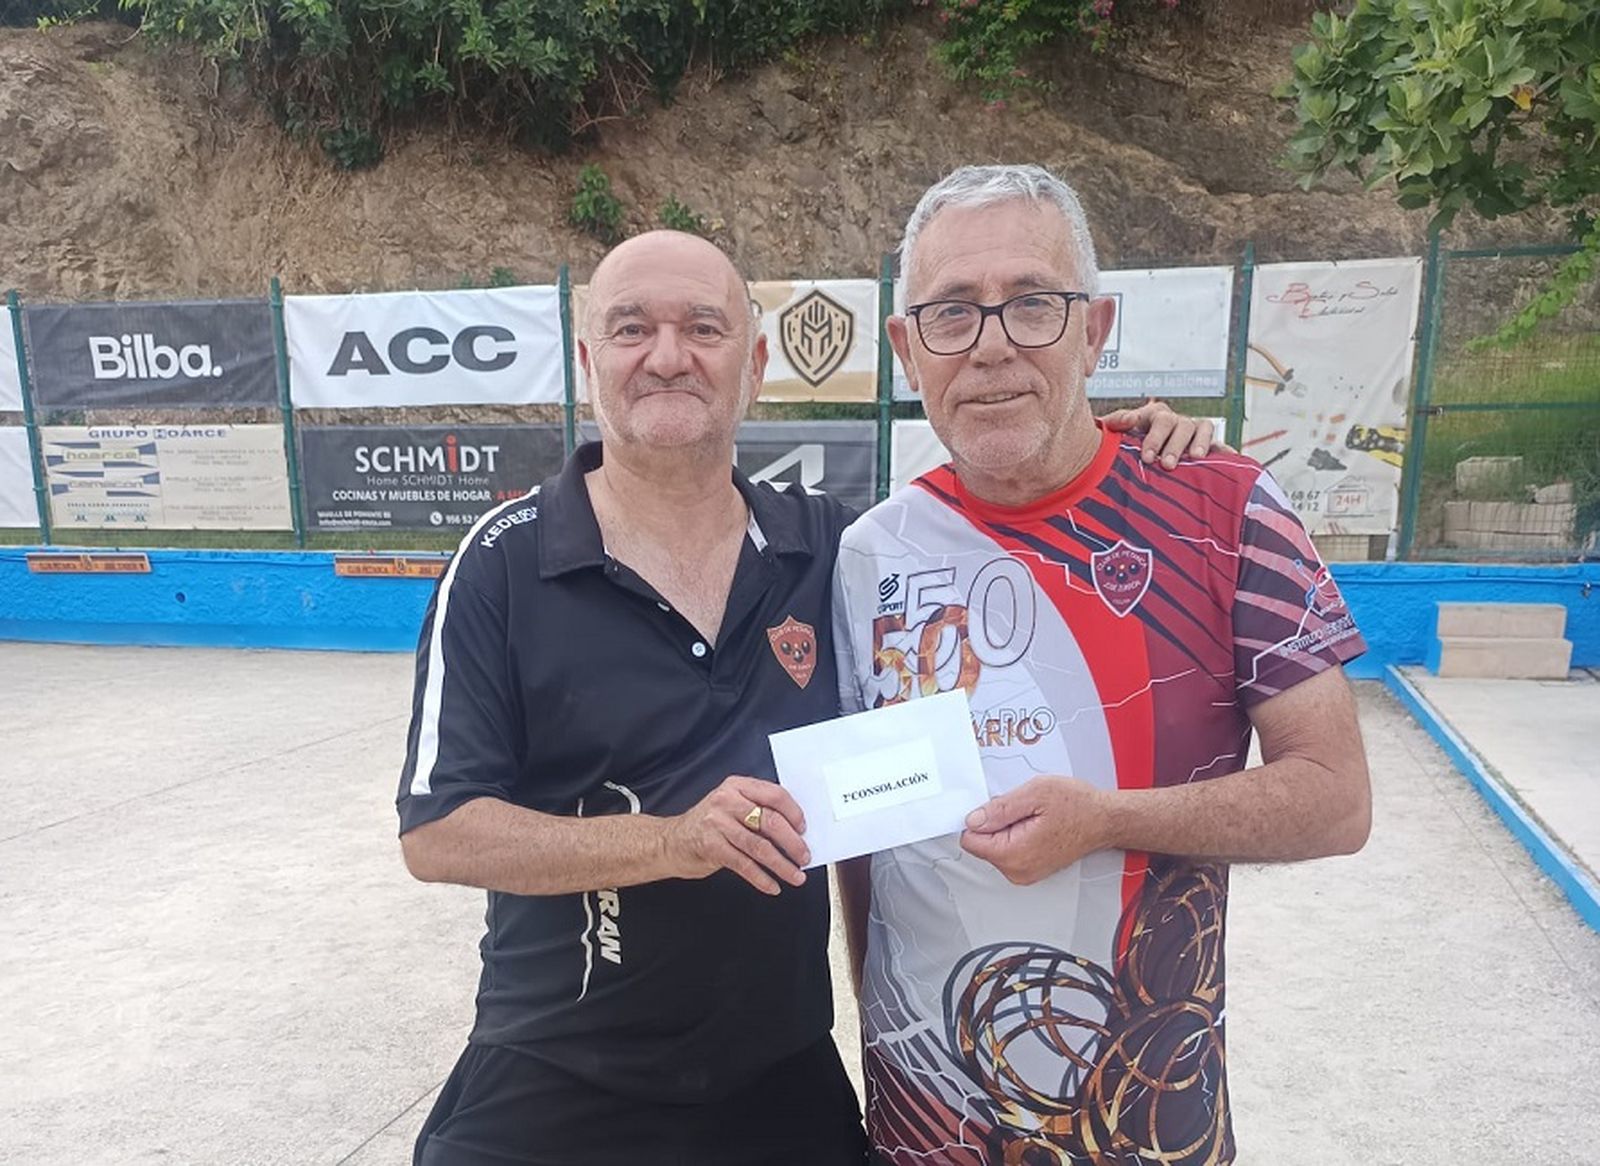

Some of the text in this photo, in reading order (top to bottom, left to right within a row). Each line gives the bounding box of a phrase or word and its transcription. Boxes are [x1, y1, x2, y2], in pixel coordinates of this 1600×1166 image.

[89, 334, 223, 379] Bilba.
[326, 325, 518, 376] ACC
[88, 429, 148, 439] GRUPO
[332, 490, 377, 501] COCINAS
[379, 490, 387, 501] Y
[388, 490, 436, 501] MUEBLES
[437, 490, 450, 501] DE
[453, 490, 492, 502] HOGAR
[367, 475, 398, 486] Home
[459, 474, 490, 486] Home
[905, 556, 1036, 668] 50
[597, 887, 622, 965] RAN
